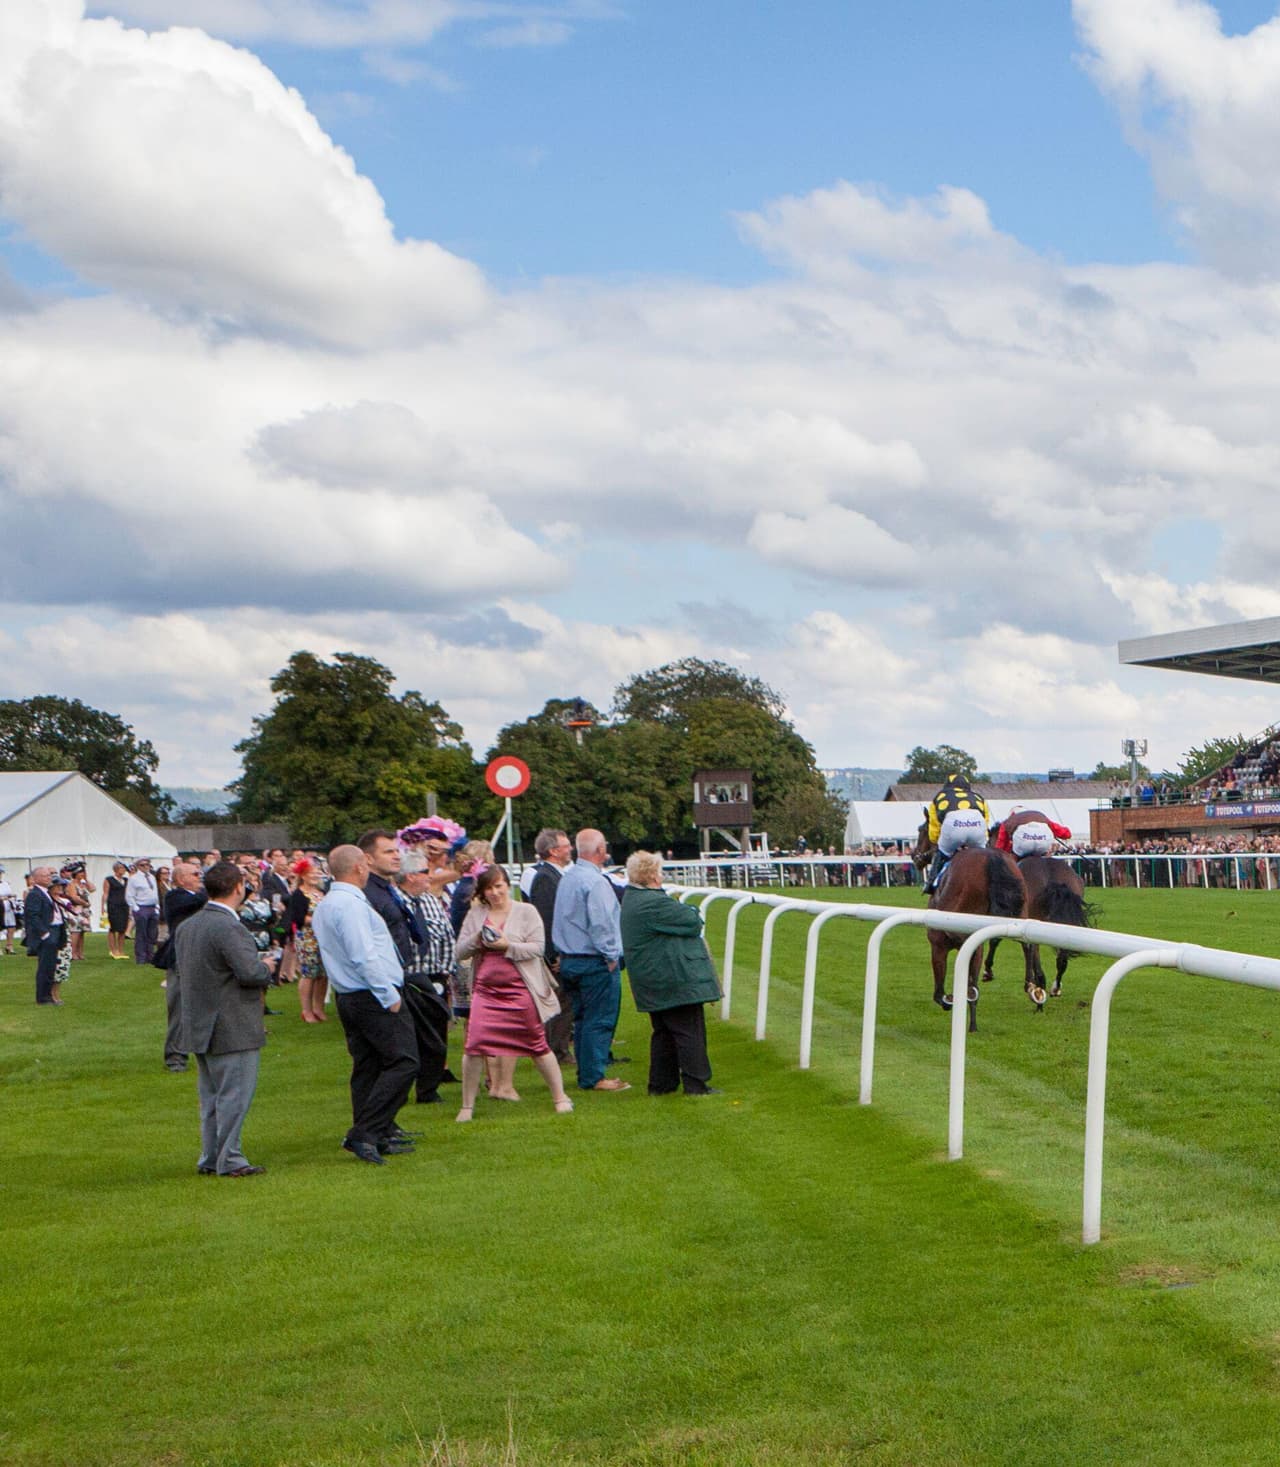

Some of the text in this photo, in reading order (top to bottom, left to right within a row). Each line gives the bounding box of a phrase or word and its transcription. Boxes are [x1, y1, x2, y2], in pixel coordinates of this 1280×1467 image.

[1216, 806, 1243, 815] TOTEPOOL
[953, 820, 981, 828] Stobart
[1022, 833, 1047, 841] Stobart
